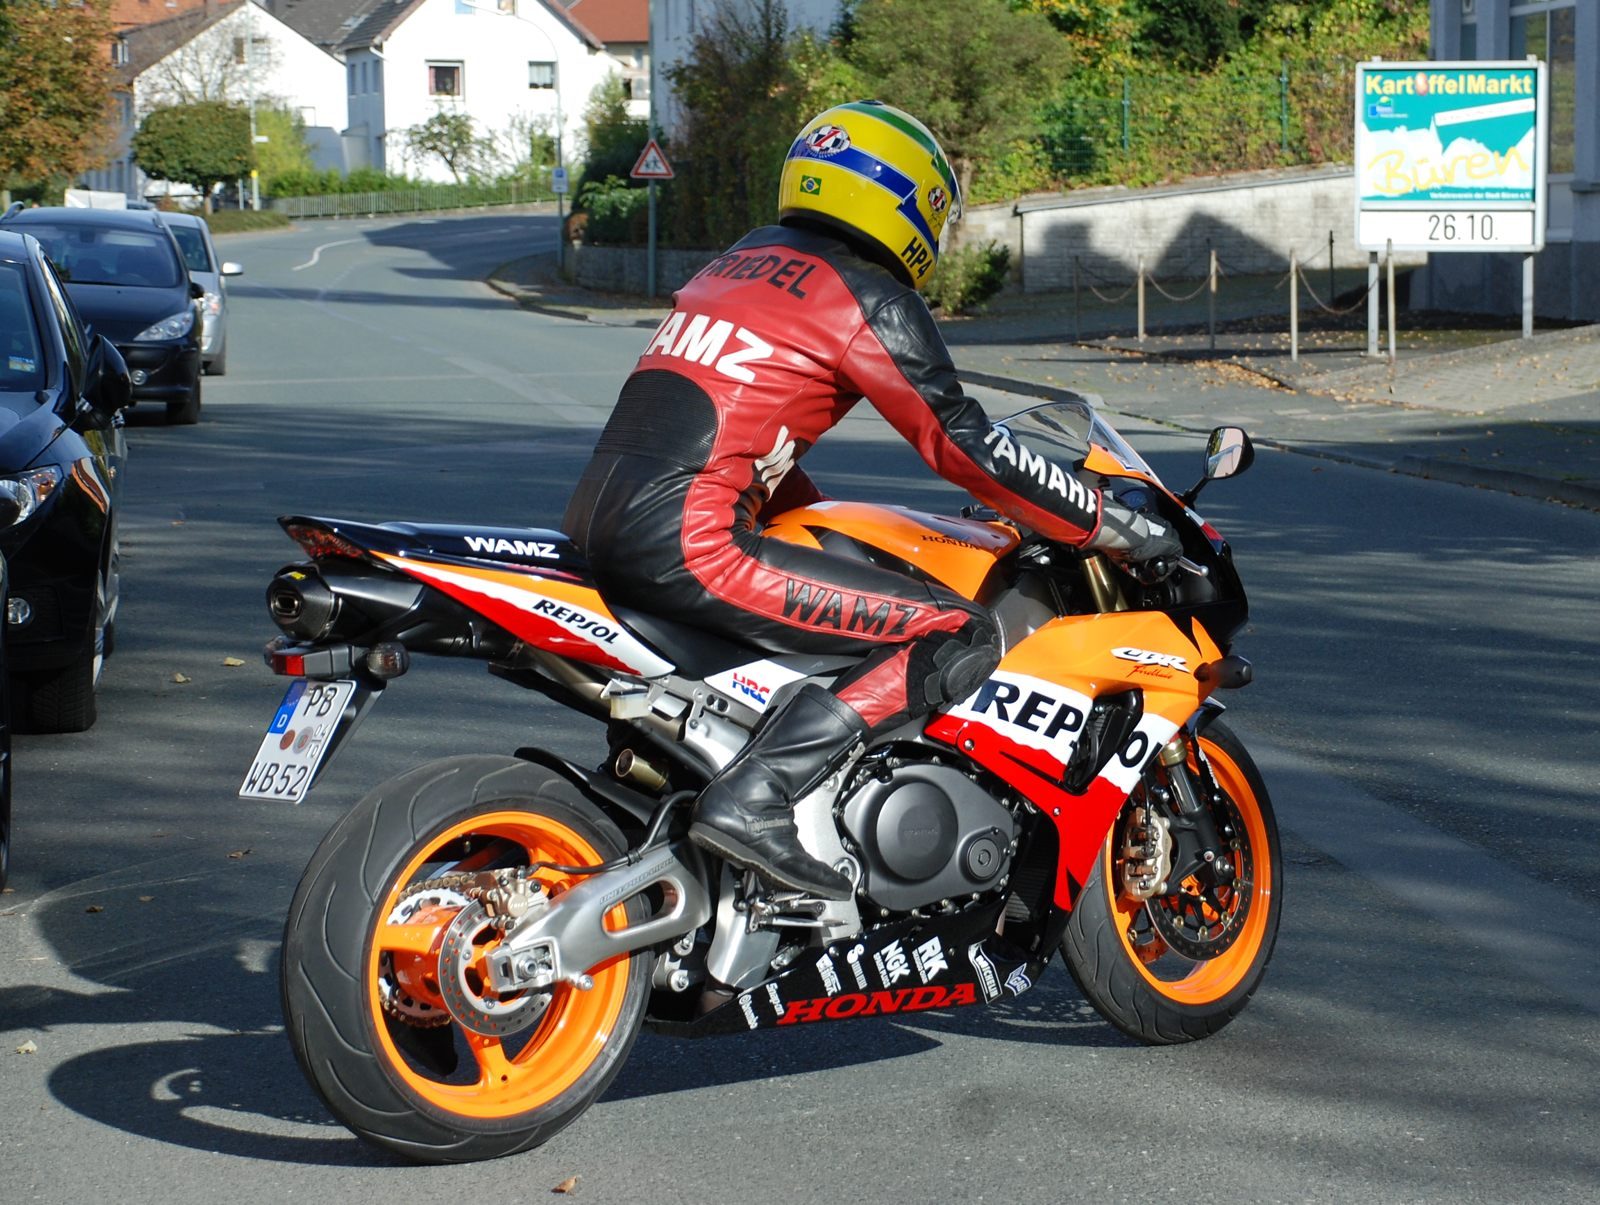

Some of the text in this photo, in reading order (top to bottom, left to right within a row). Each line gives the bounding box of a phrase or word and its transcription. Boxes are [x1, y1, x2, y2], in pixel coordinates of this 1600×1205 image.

[1367, 147, 1530, 194] Büren
[1428, 214, 1498, 240] 26.10.
[901, 236, 934, 279] HP4
[643, 312, 774, 383] AMZ
[464, 535, 559, 559] WAMZ
[920, 535, 980, 550] HONDA
[532, 599, 620, 644] REPSOL
[780, 579, 918, 636] WAMZ
[1110, 647, 1190, 674] CBR
[303, 685, 338, 717] PB
[732, 672, 770, 705] HRC
[277, 714, 288, 728] D
[245, 762, 309, 796] WB52
[880, 939, 911, 984] NGK
[917, 936, 949, 981] RK
[976, 955, 999, 998] MICHELIN
[776, 983, 976, 1026] HONDA
